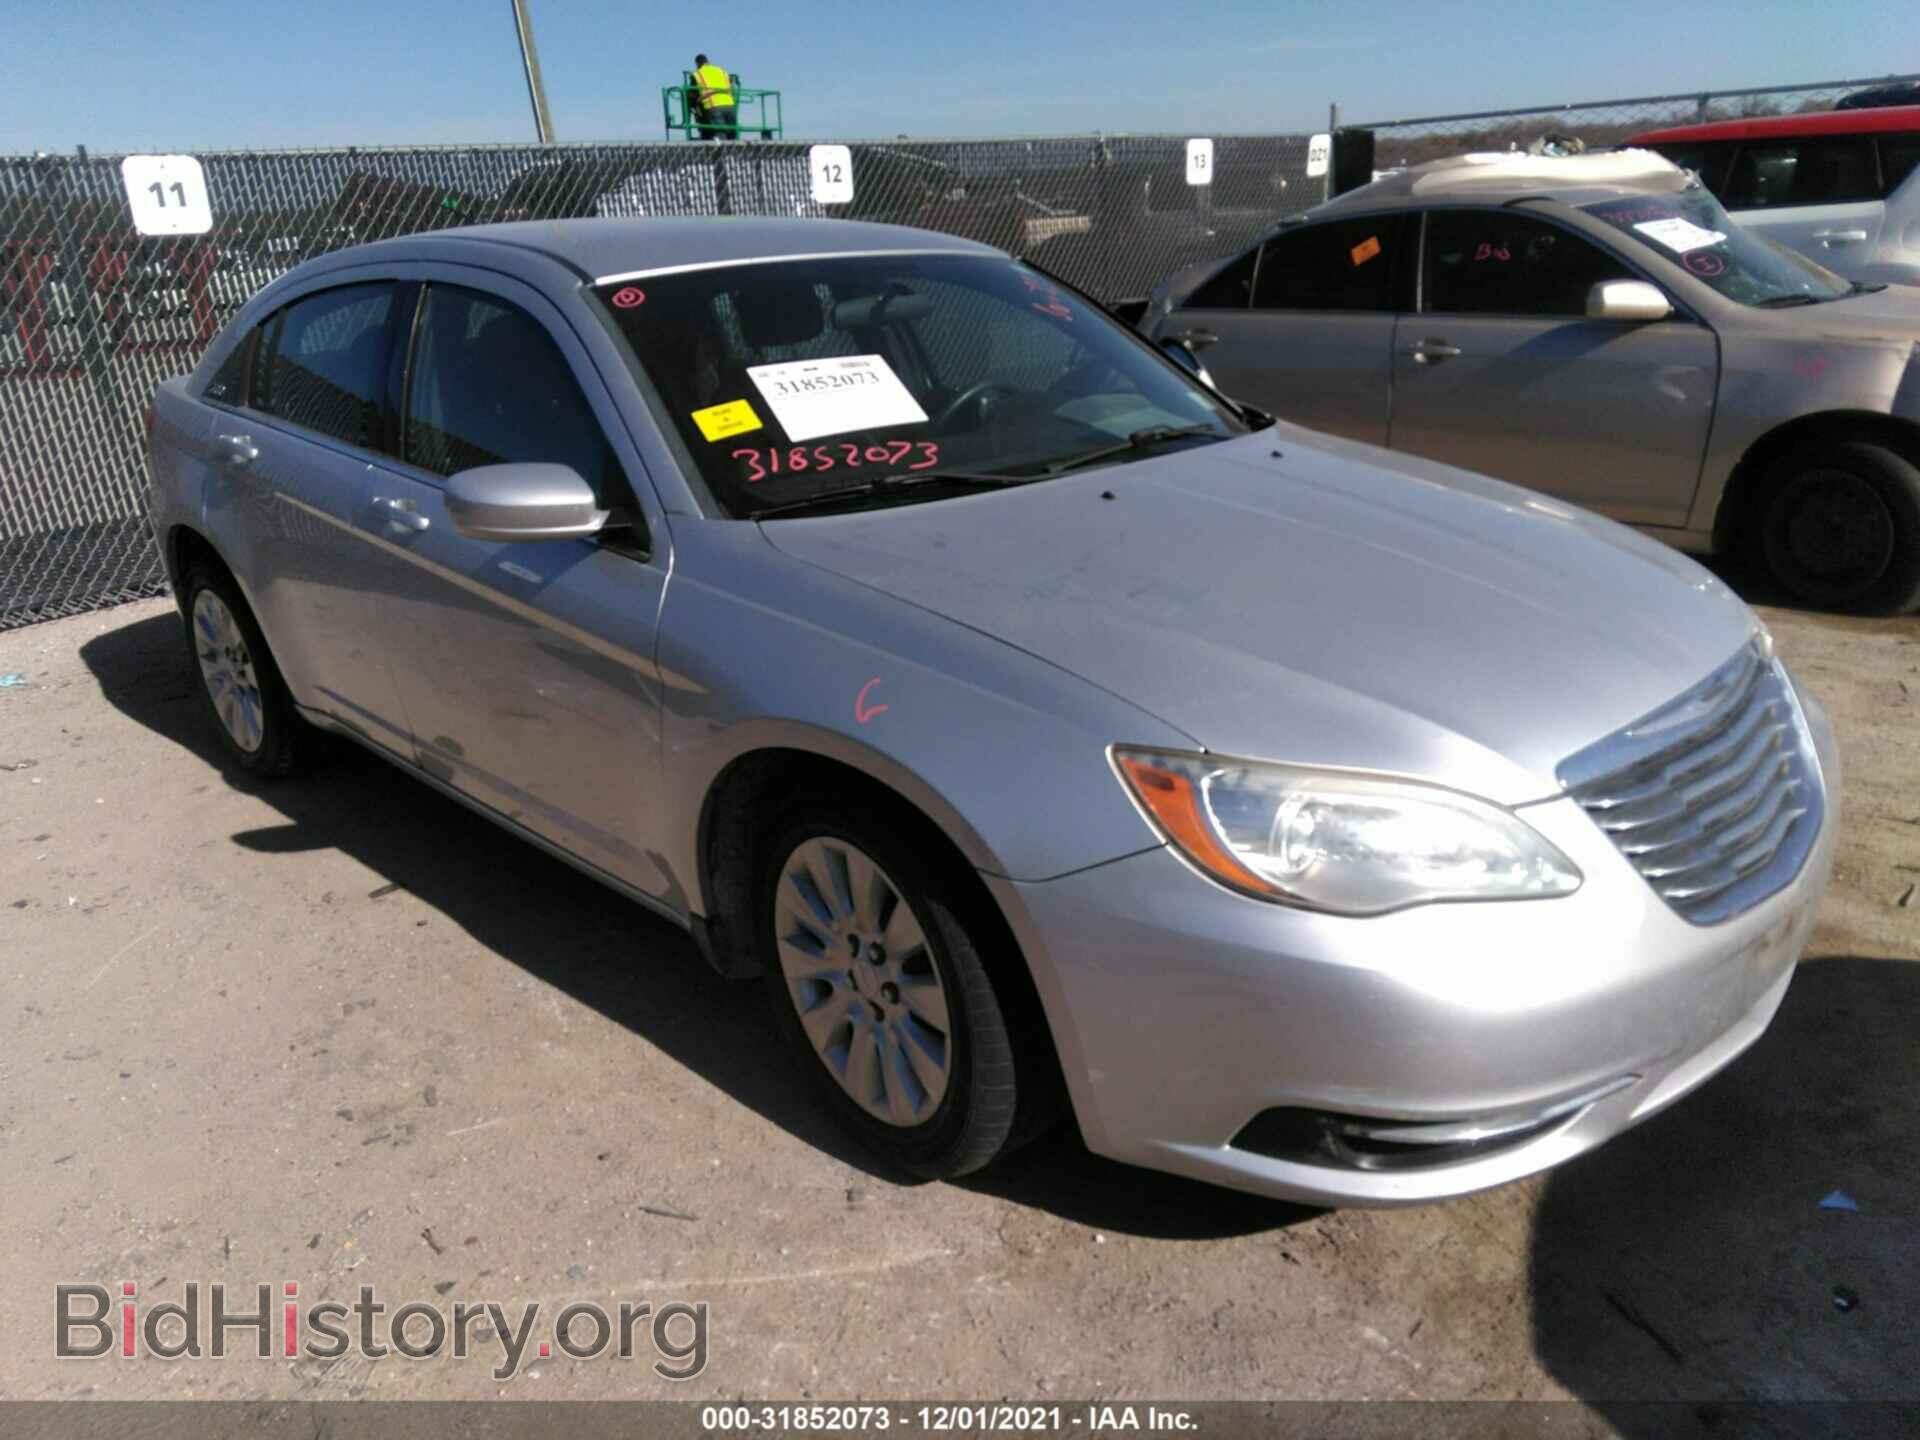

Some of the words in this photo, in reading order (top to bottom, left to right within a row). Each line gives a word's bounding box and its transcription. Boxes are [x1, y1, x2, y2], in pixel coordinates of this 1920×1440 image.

[822, 164, 843, 183] 12
[1194, 154, 1206, 169] 13
[148, 182, 187, 207] 11
[773, 371, 880, 396] 31852073
[732, 441, 939, 481] 31852073
